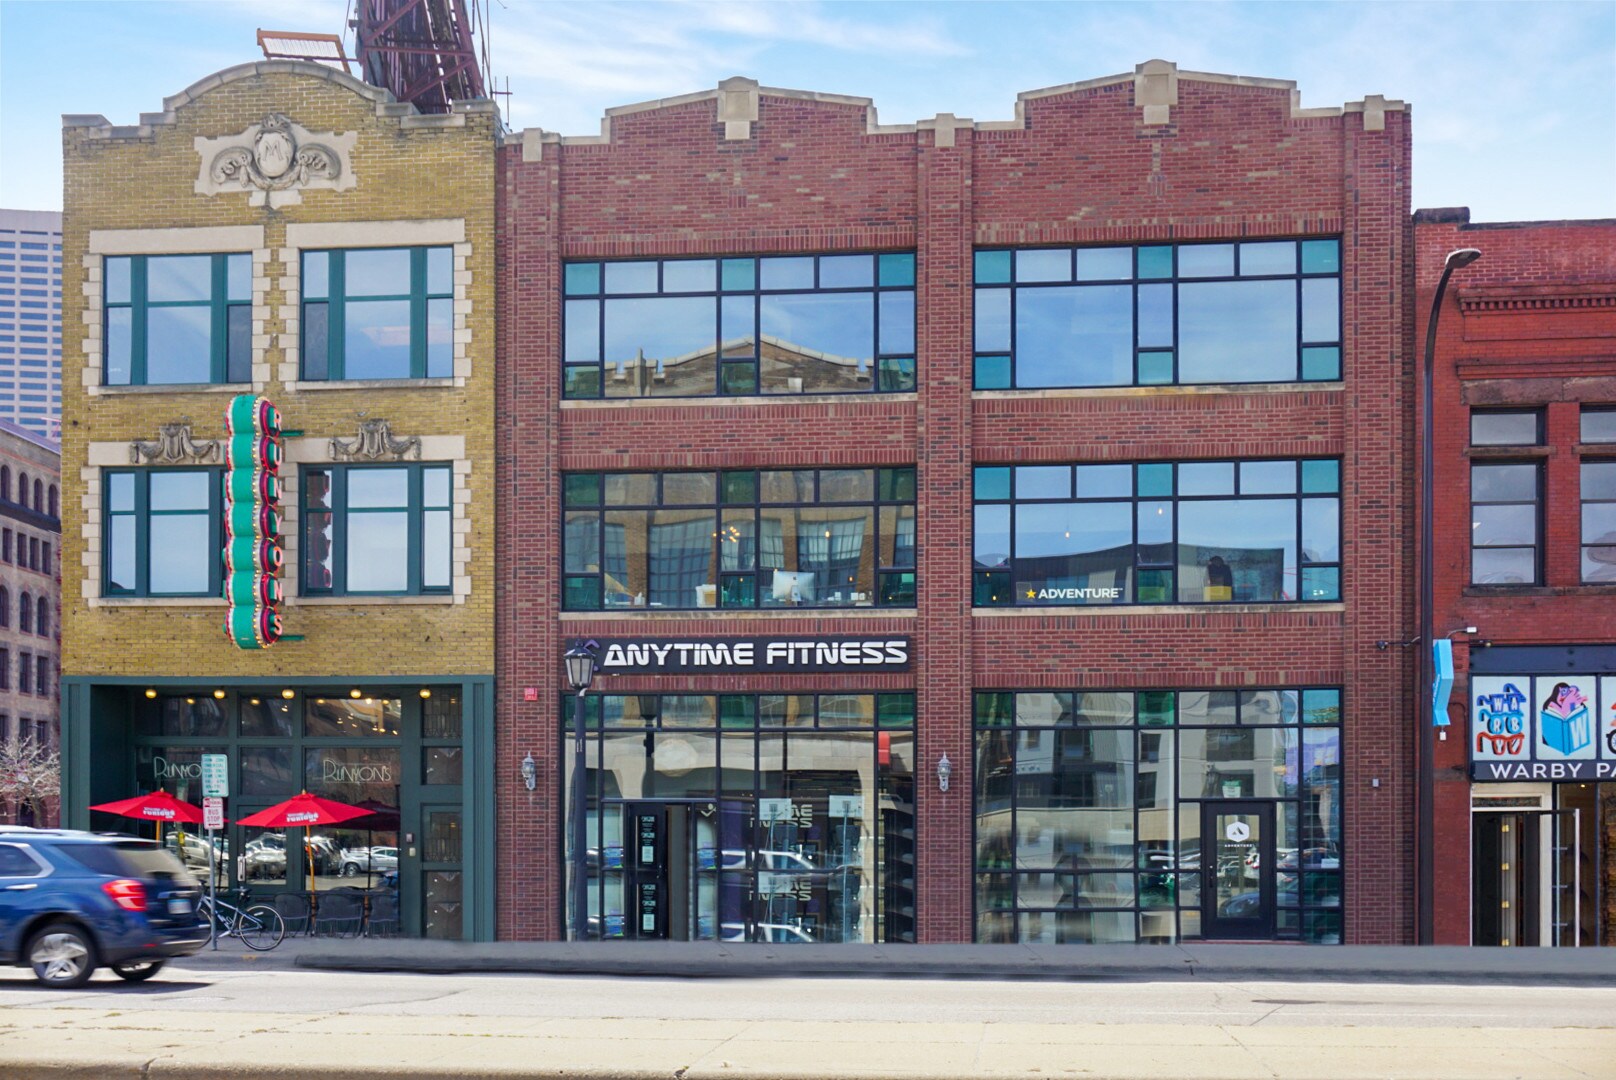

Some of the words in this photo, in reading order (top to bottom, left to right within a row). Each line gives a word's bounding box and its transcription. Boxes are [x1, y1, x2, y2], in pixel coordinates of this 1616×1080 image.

[603, 643, 754, 666] ANYTIME
[767, 641, 908, 665] FITNESS
[1490, 763, 1583, 778] WARBY
